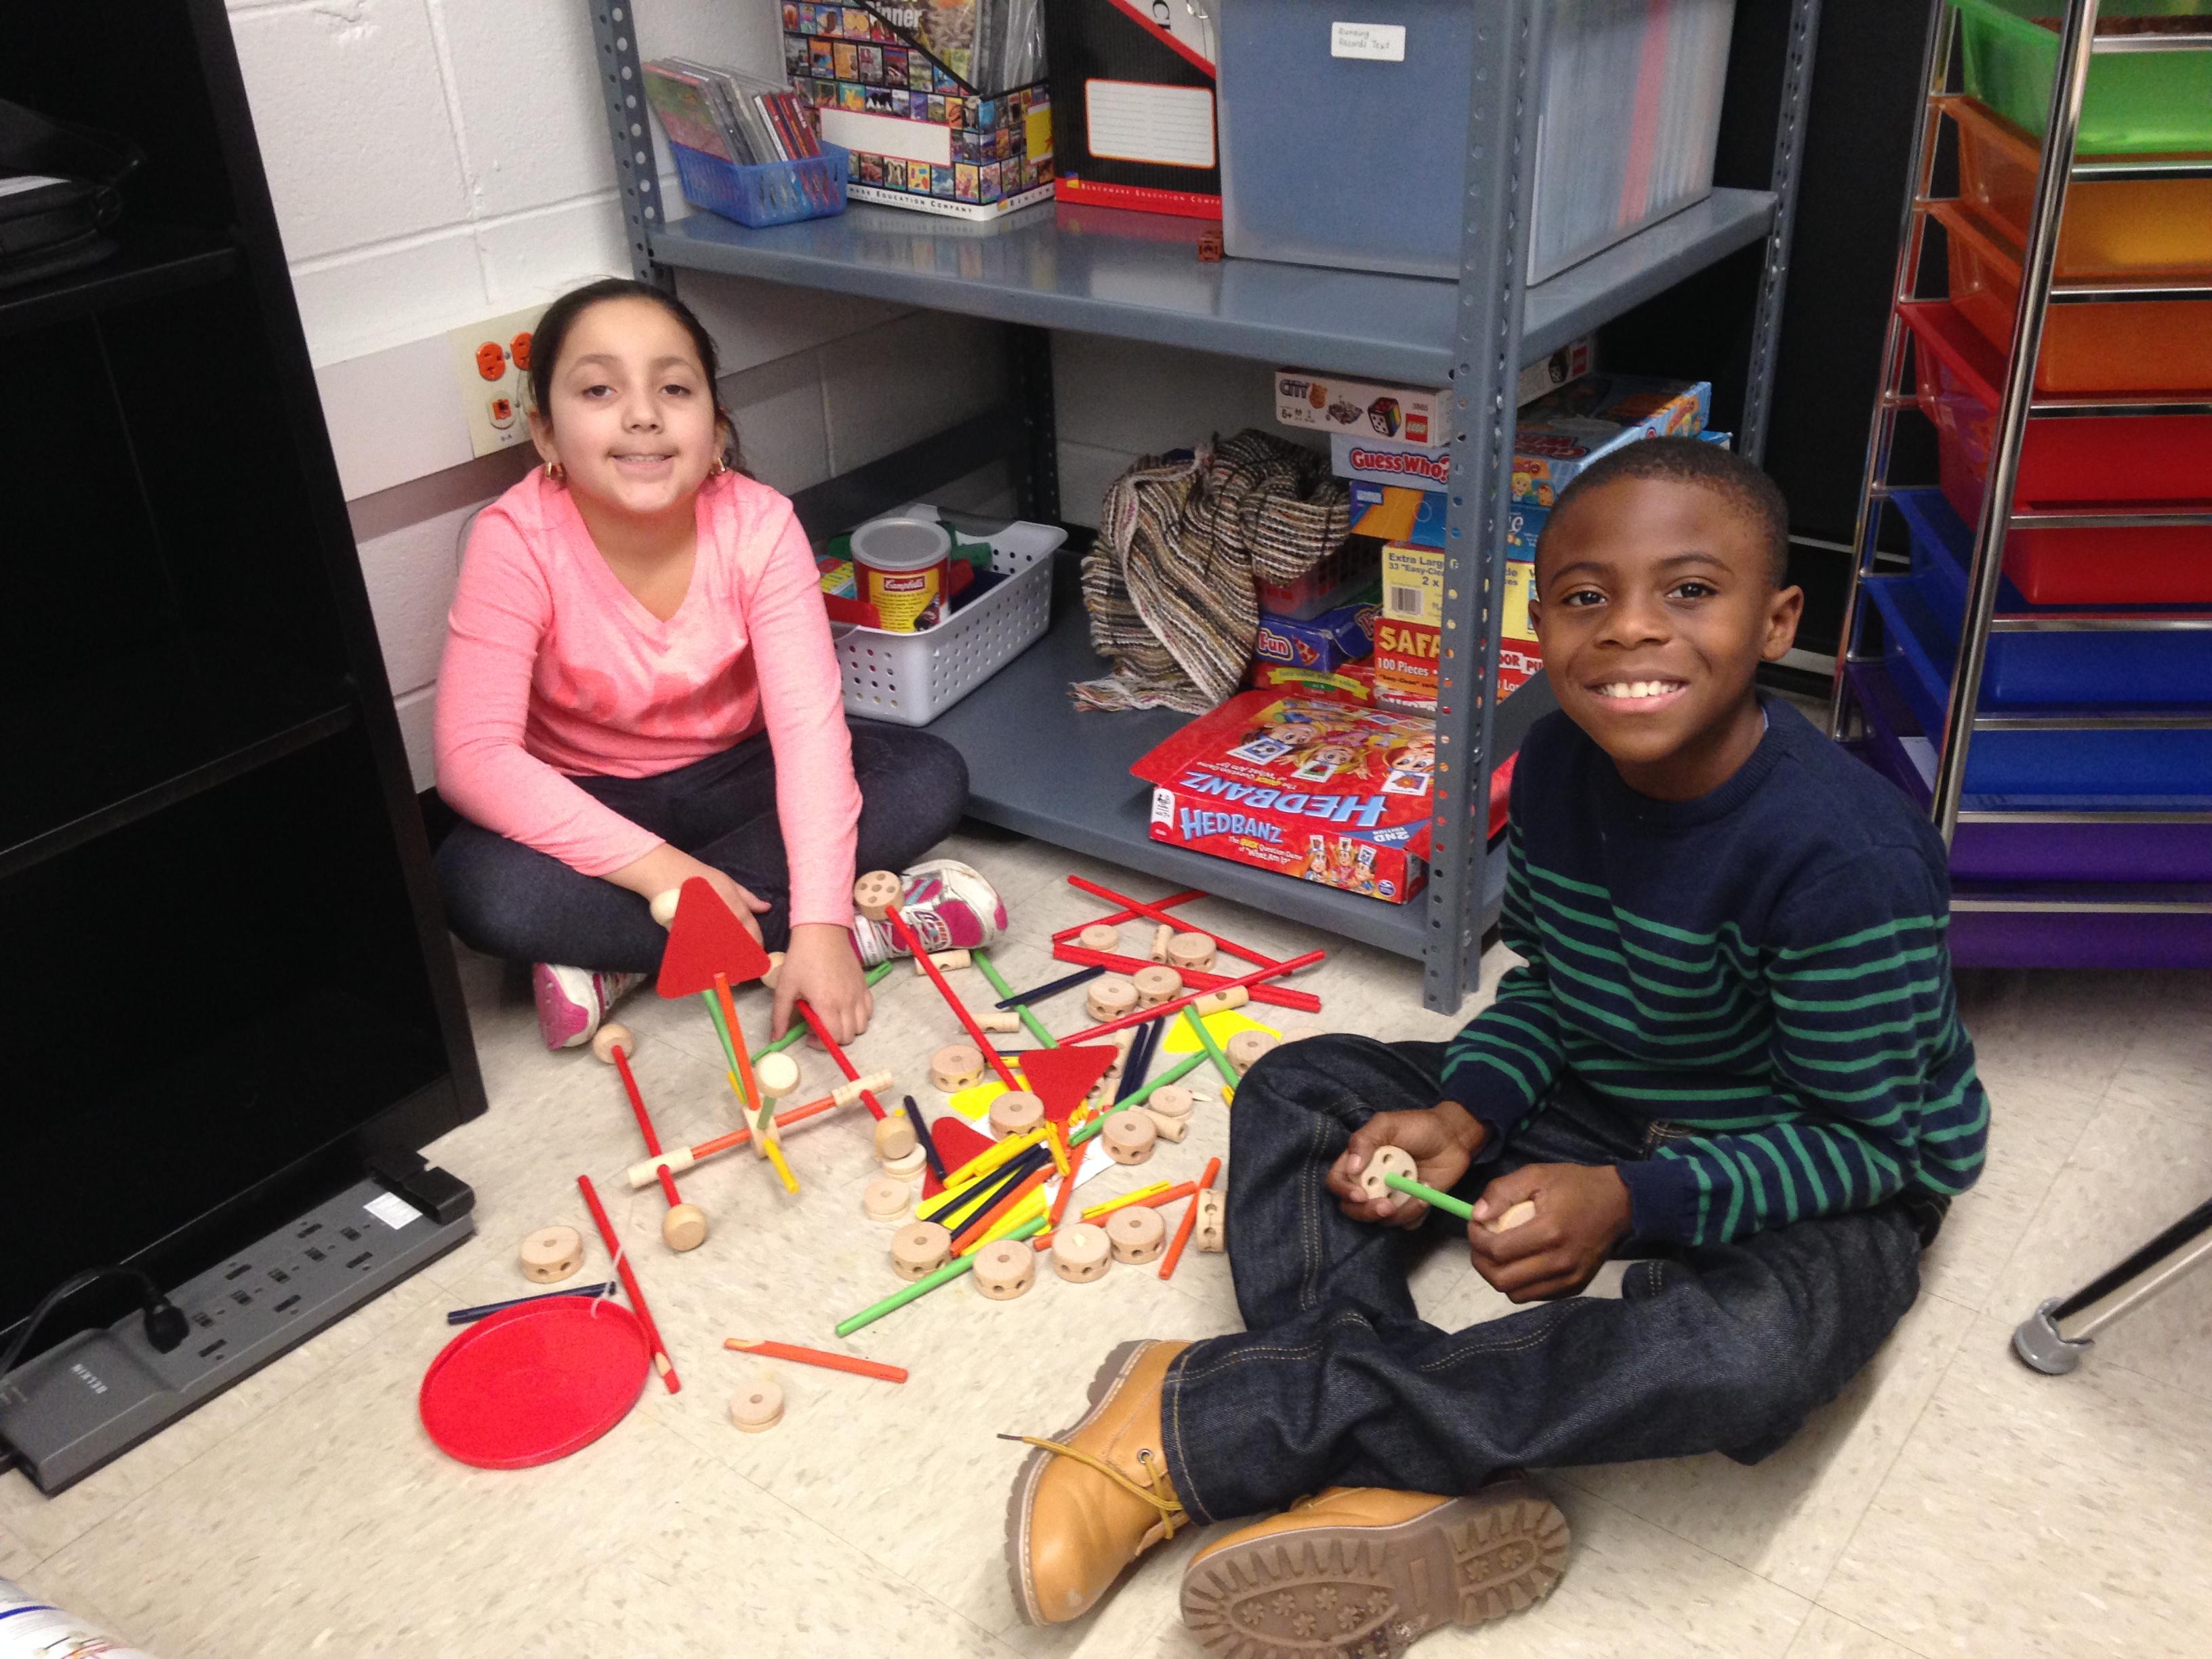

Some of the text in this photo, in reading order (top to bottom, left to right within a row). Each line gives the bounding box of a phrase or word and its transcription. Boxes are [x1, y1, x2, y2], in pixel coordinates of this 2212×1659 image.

[1372, 40, 1389, 49] Text
[876, 190, 925, 205] EDUCATION
[930, 199, 972, 213] COMPANY
[1190, 195, 1221, 205] COMPA
[1279, 379, 1310, 398] CITY
[1282, 409, 1292, 419] 6+
[1389, 552, 1443, 569] Extra Larg
[1401, 564, 1444, 575] "Easy-Cle
[1422, 576, 1429, 586] 2
[1258, 631, 1289, 655] Fun
[1378, 626, 1441, 658] SAFA
[1377, 657, 1429, 676] 100 Pieces
[1179, 771, 1388, 827] HEDBANZ
[1179, 807, 1284, 842] HEDBANZ
[1372, 827, 1406, 836] EDITION
[1374, 830, 1410, 842] 2ND
